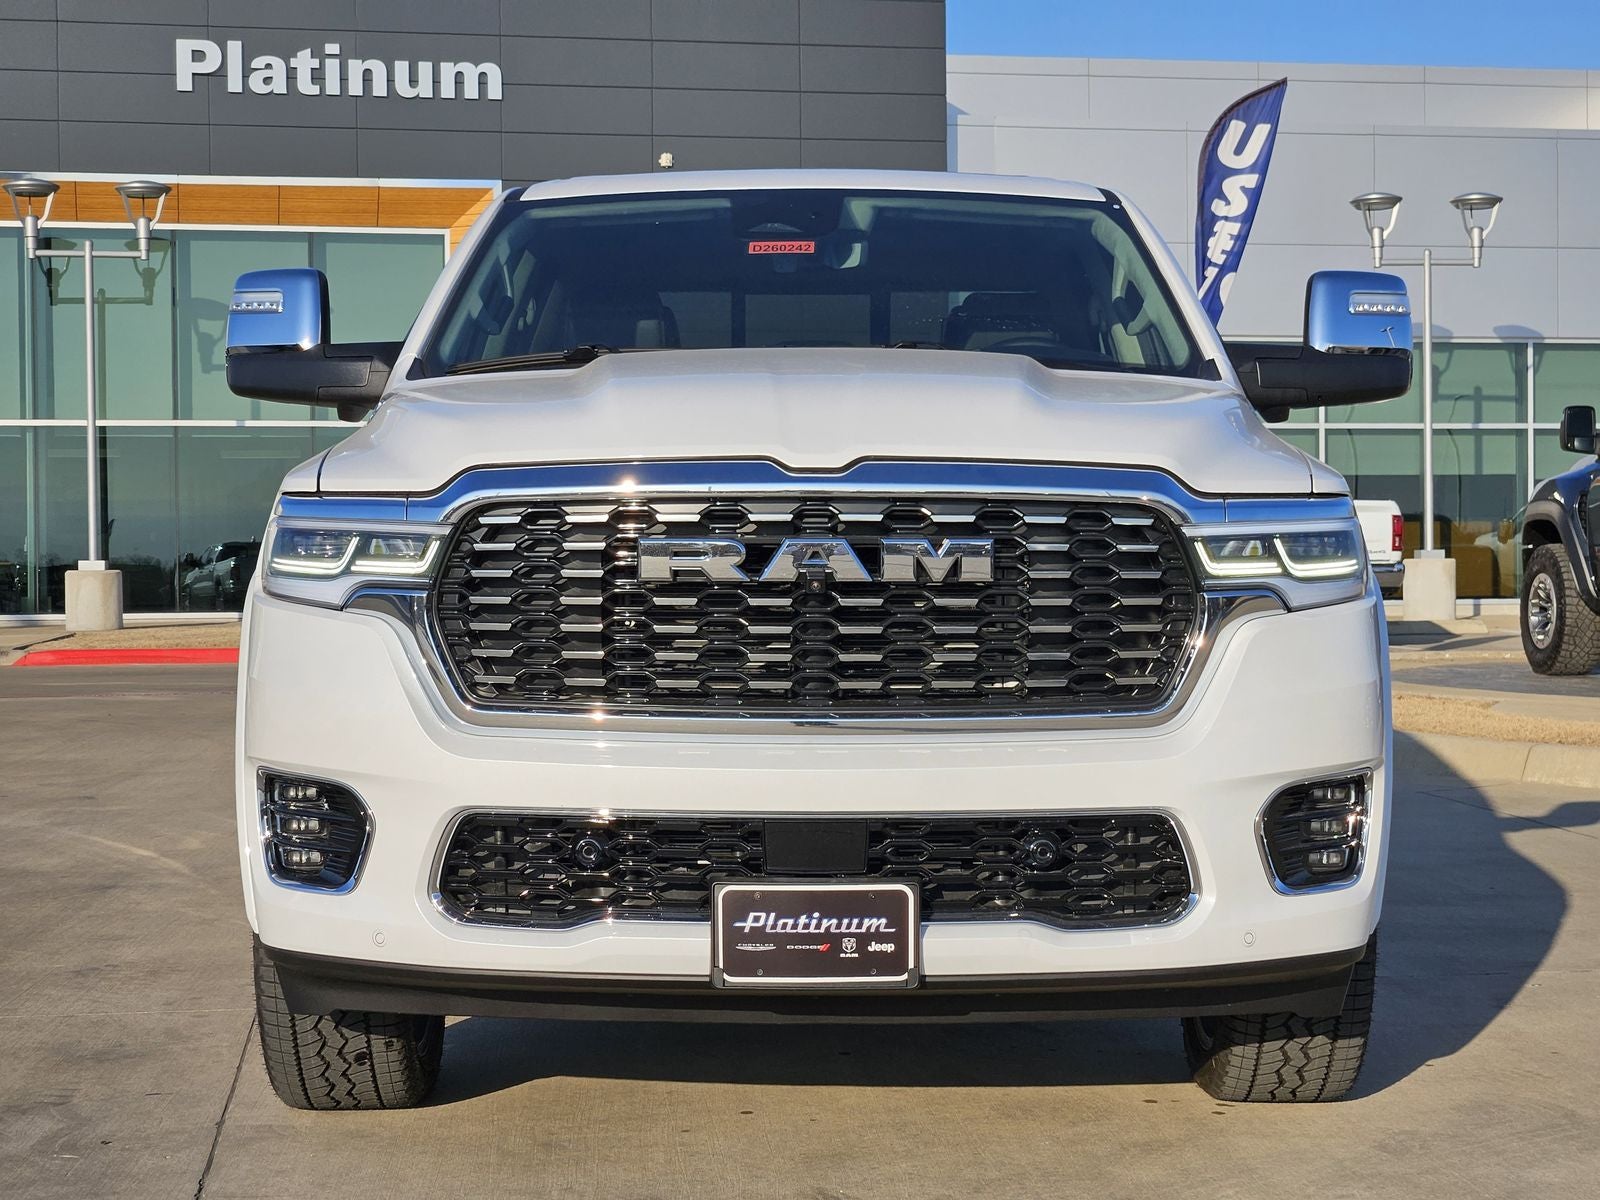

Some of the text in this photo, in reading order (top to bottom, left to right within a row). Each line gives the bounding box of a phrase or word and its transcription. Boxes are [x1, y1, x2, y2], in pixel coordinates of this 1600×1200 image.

[175, 38, 503, 101] Platinum
[752, 244, 812, 253] D260242
[637, 537, 994, 583] RAM
[733, 911, 896, 934] Platinum
[867, 941, 895, 953] Jeep
